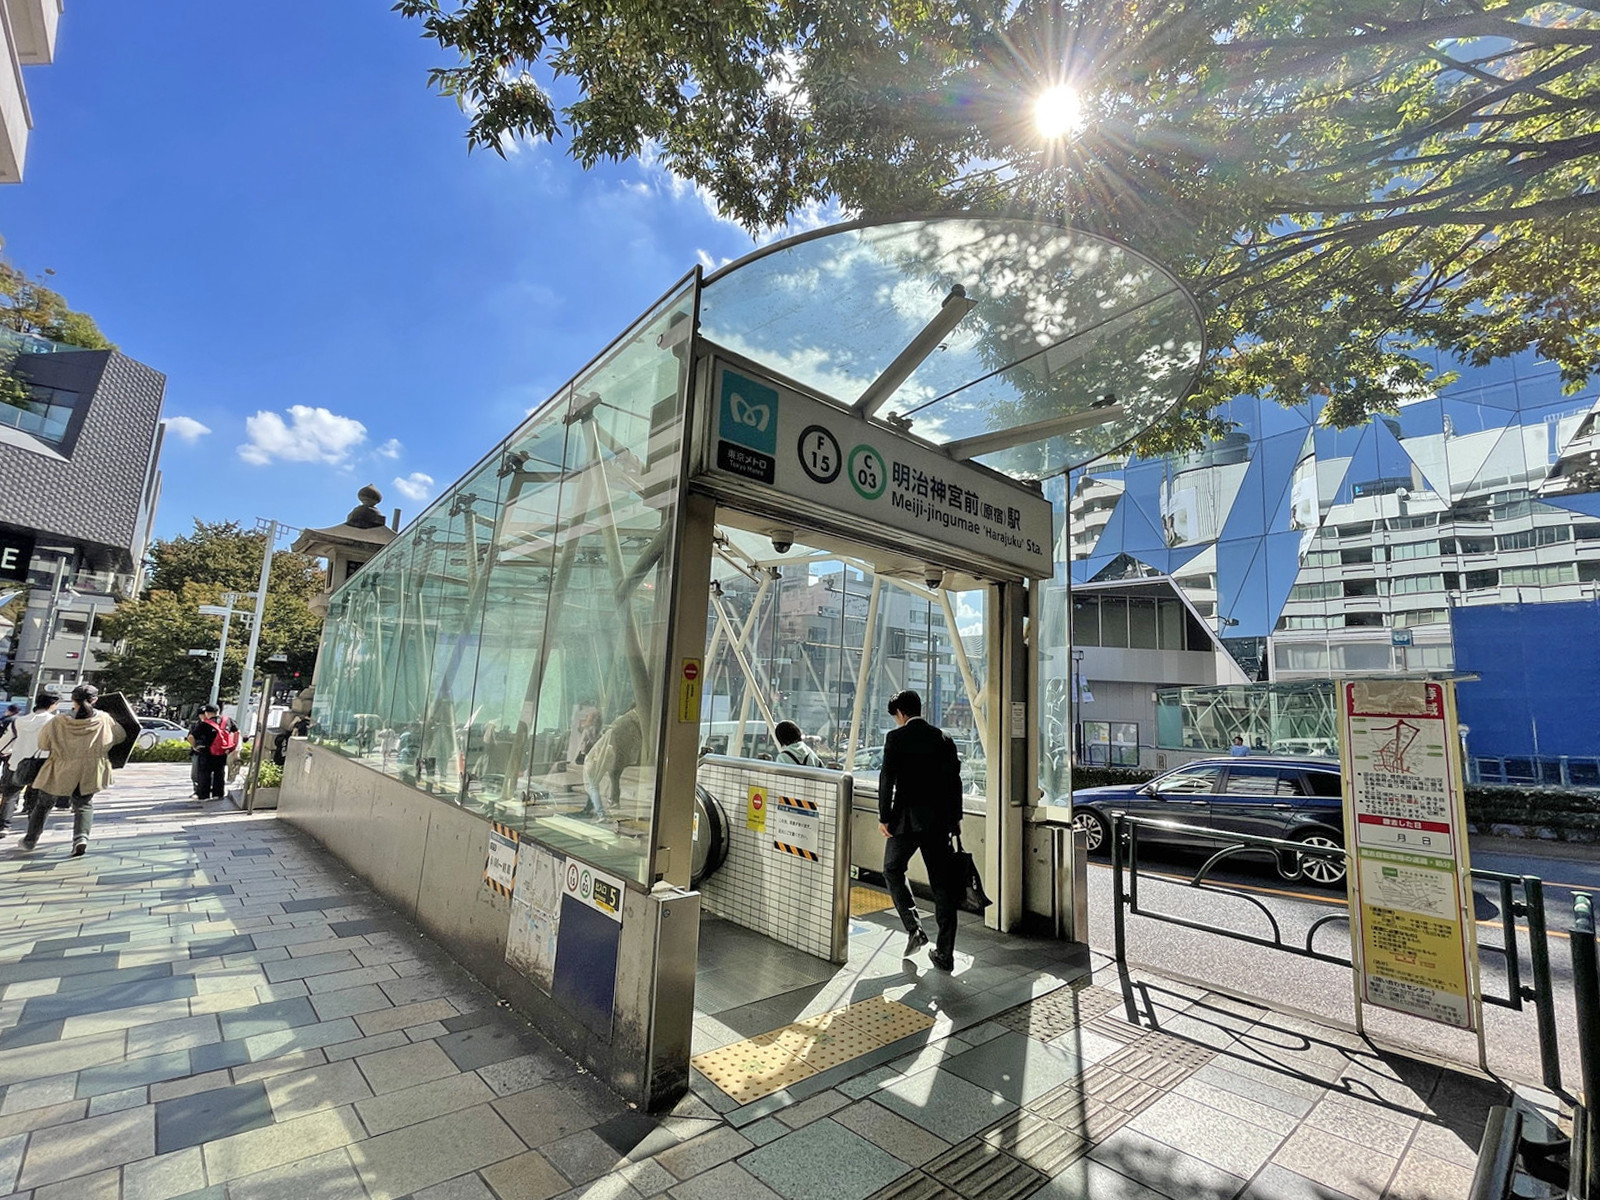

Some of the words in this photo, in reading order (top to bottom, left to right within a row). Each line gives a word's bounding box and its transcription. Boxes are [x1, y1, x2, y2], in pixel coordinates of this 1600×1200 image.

[817, 435, 825, 451] F
[811, 451, 830, 473] 15
[864, 454, 873, 470] C
[858, 469, 877, 489] 03
[891, 490, 980, 535] Meiji-jingumae
[1026, 538, 1043, 556] Sta.
[1397, 833, 1406, 843] 月
[610, 888, 617, 907] 5
